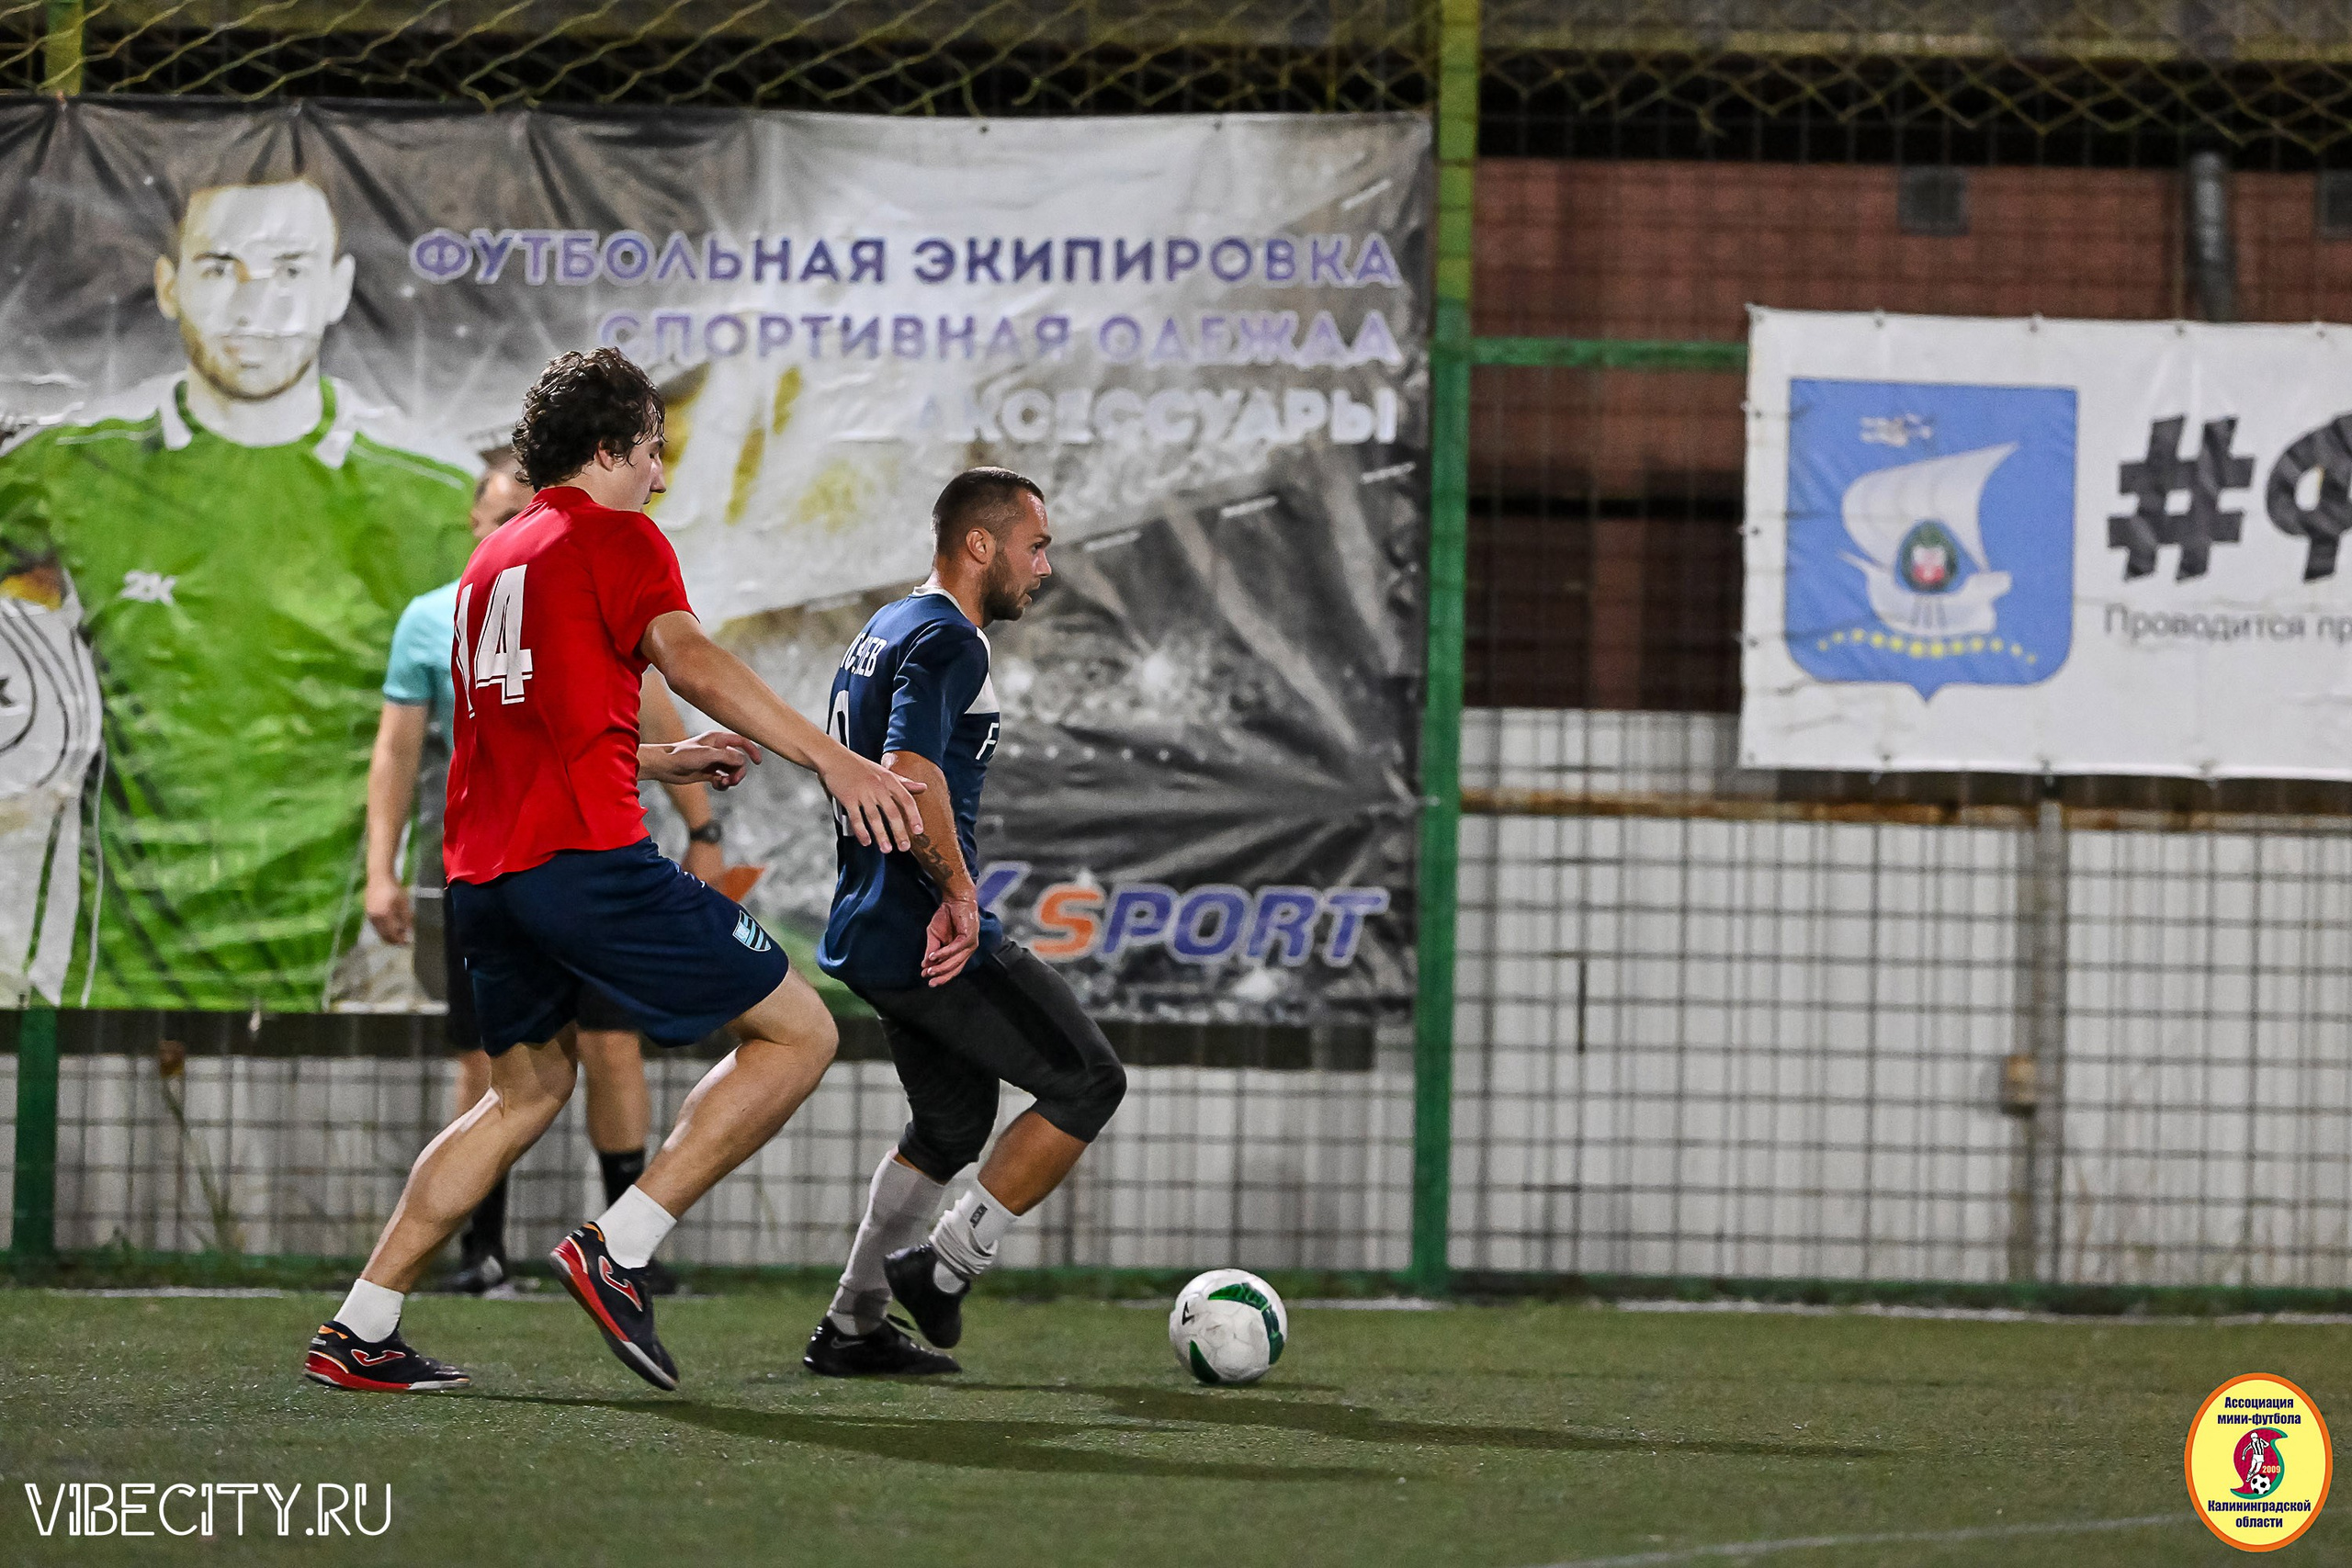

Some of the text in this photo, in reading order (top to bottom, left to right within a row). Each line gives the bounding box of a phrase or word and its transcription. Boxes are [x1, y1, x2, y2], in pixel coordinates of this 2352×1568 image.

[410, 228, 1401, 287] ФУТБОЛЬНАЯ ЭКИПИРОВКА
[598, 310, 1402, 367] СПОРТИВНАЯ ОДЕЖДА
[454, 564, 533, 719] 14
[2103, 603, 2305, 643] Проводится
[1032, 883, 1390, 968] SPORT
